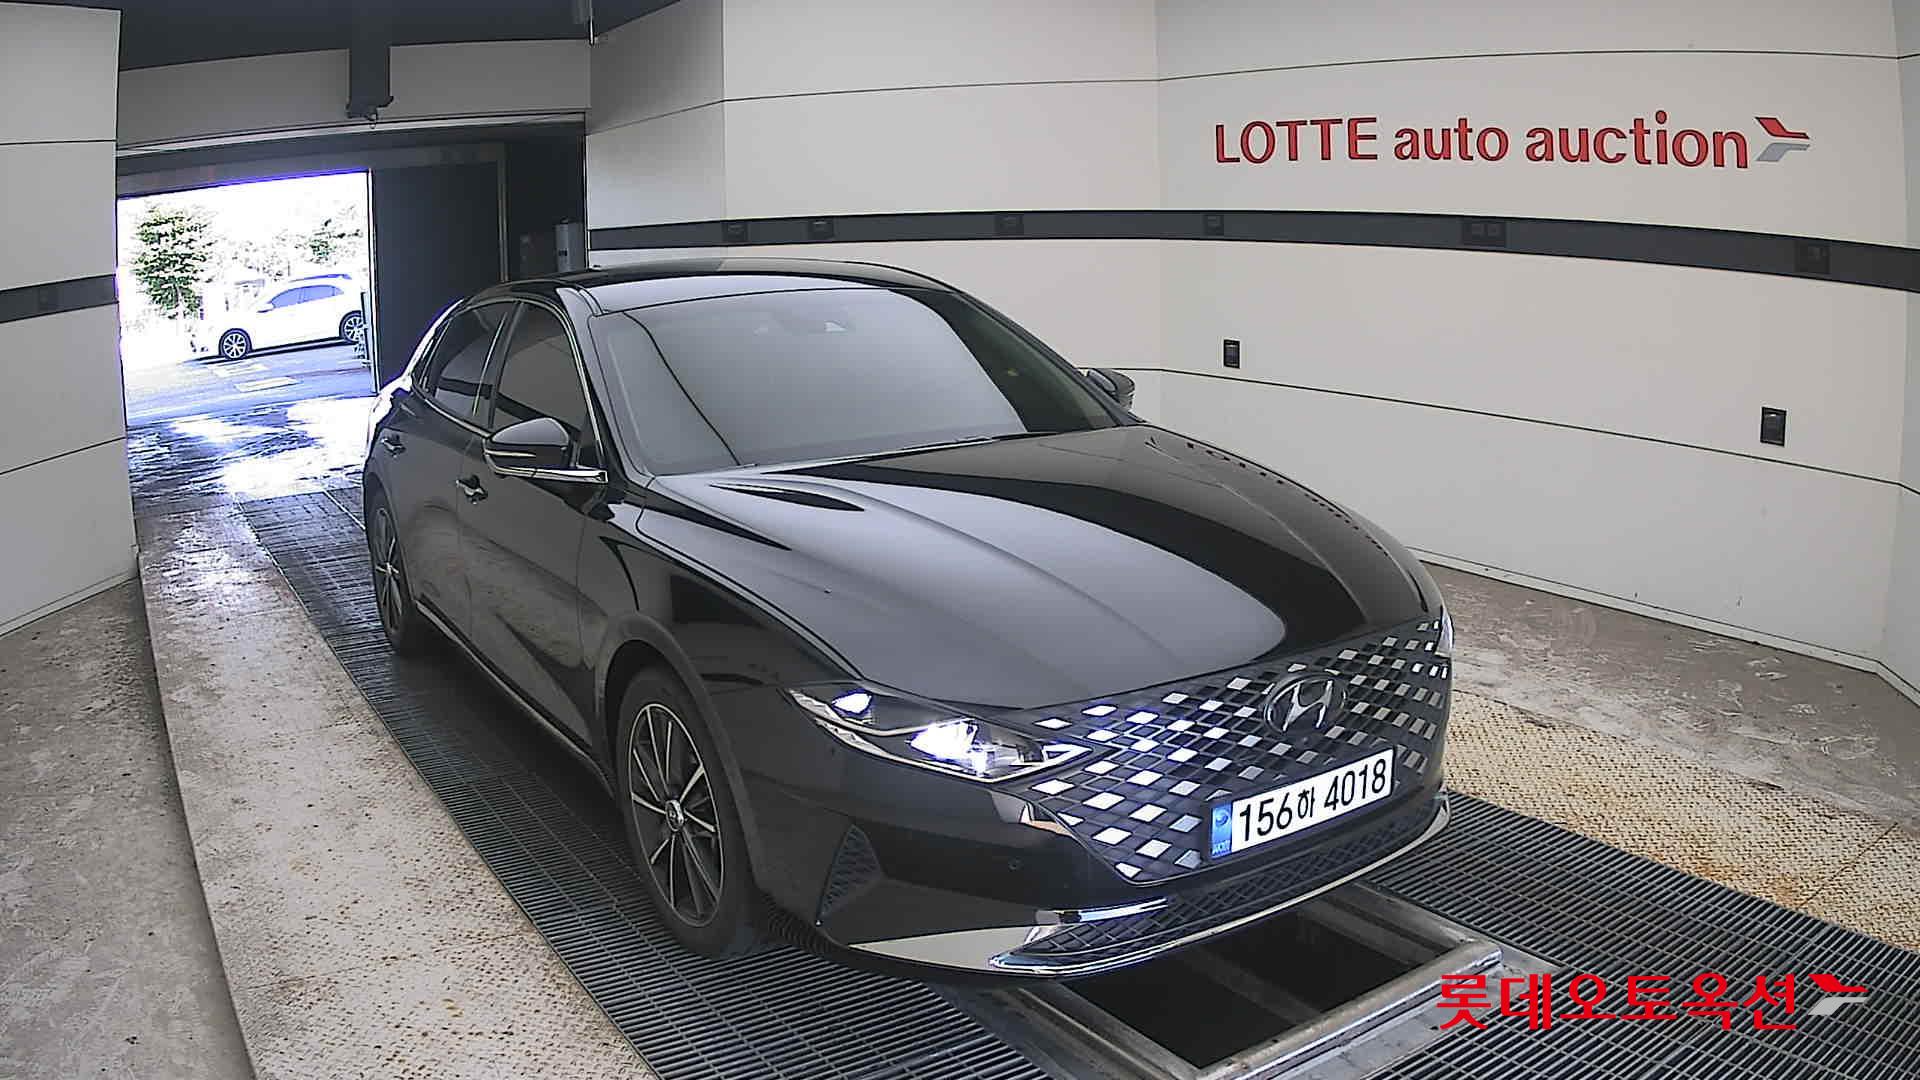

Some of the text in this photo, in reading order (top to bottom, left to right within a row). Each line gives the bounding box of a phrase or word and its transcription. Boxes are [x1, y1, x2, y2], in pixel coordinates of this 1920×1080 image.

[1216, 110, 1748, 169] LOTTE auto auction
[1239, 758, 1386, 841] 156하 4018
